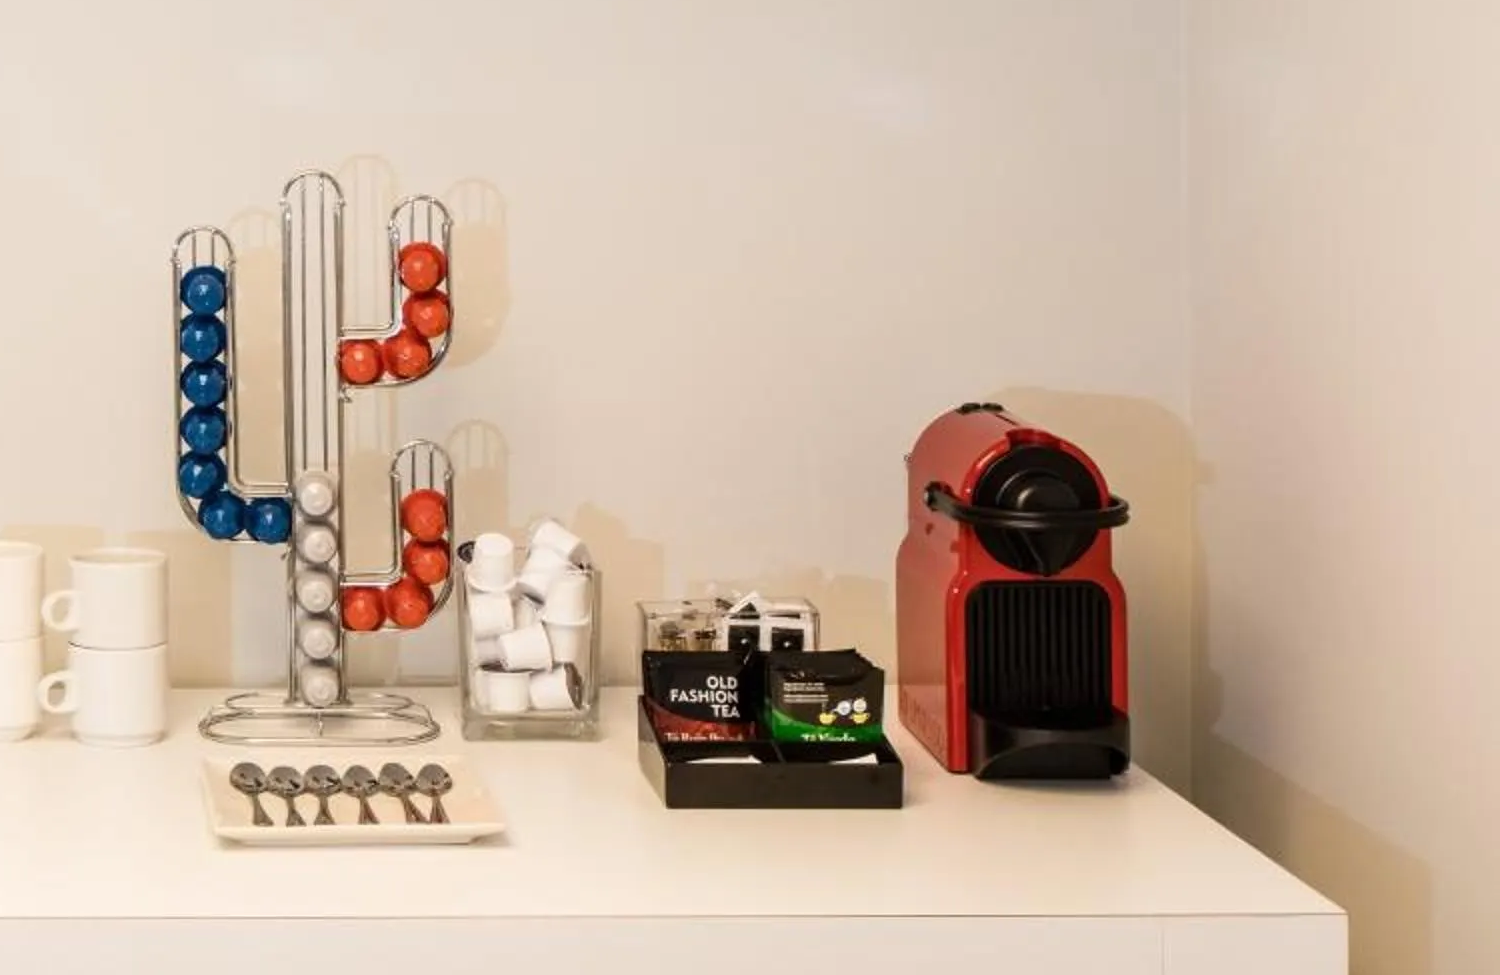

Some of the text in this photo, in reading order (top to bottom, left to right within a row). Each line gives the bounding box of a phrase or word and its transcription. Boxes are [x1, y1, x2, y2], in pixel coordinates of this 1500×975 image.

[706, 675, 739, 690] OLD
[669, 688, 739, 704] FASHION
[710, 704, 741, 718] TEA
